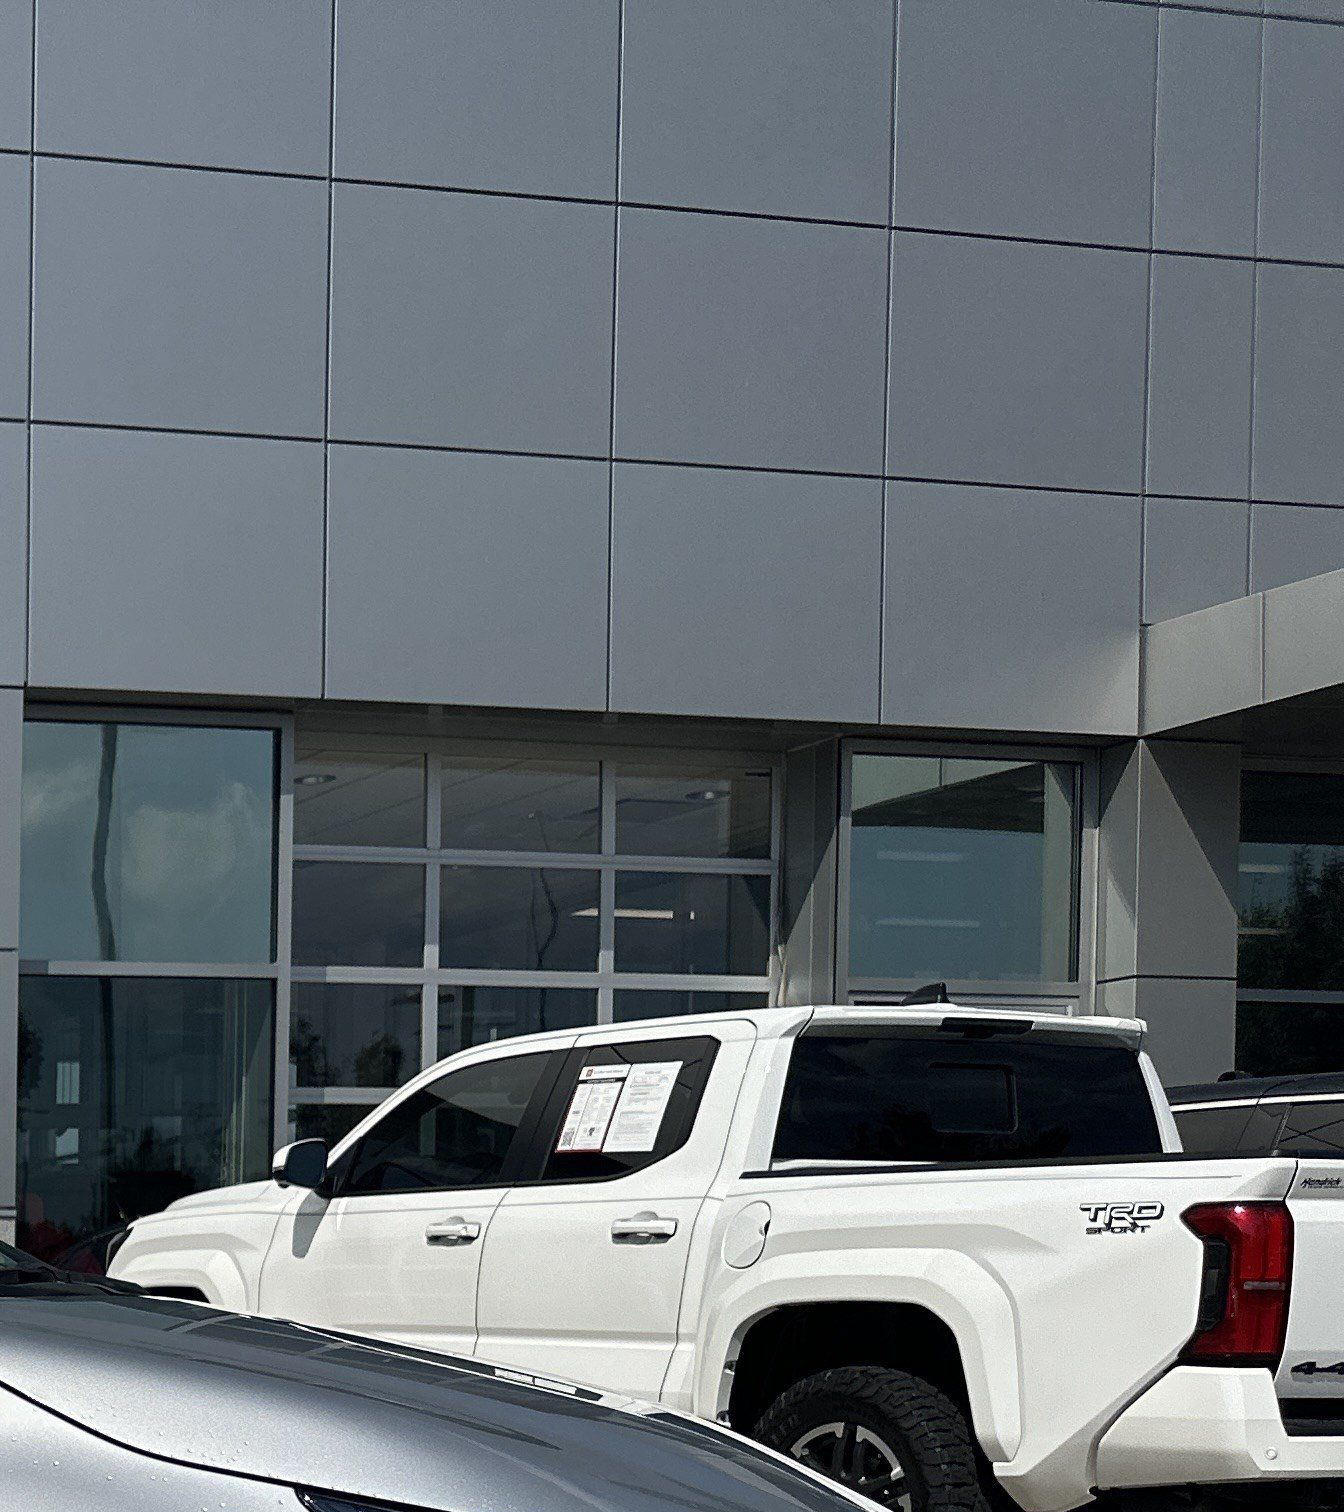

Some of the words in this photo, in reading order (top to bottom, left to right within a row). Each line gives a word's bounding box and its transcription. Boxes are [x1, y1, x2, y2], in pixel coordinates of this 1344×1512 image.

[1300, 1178, 1341, 1189] Hendrick
[1080, 1202, 1164, 1228] TRD
[1086, 1225, 1151, 1235] SPORT
